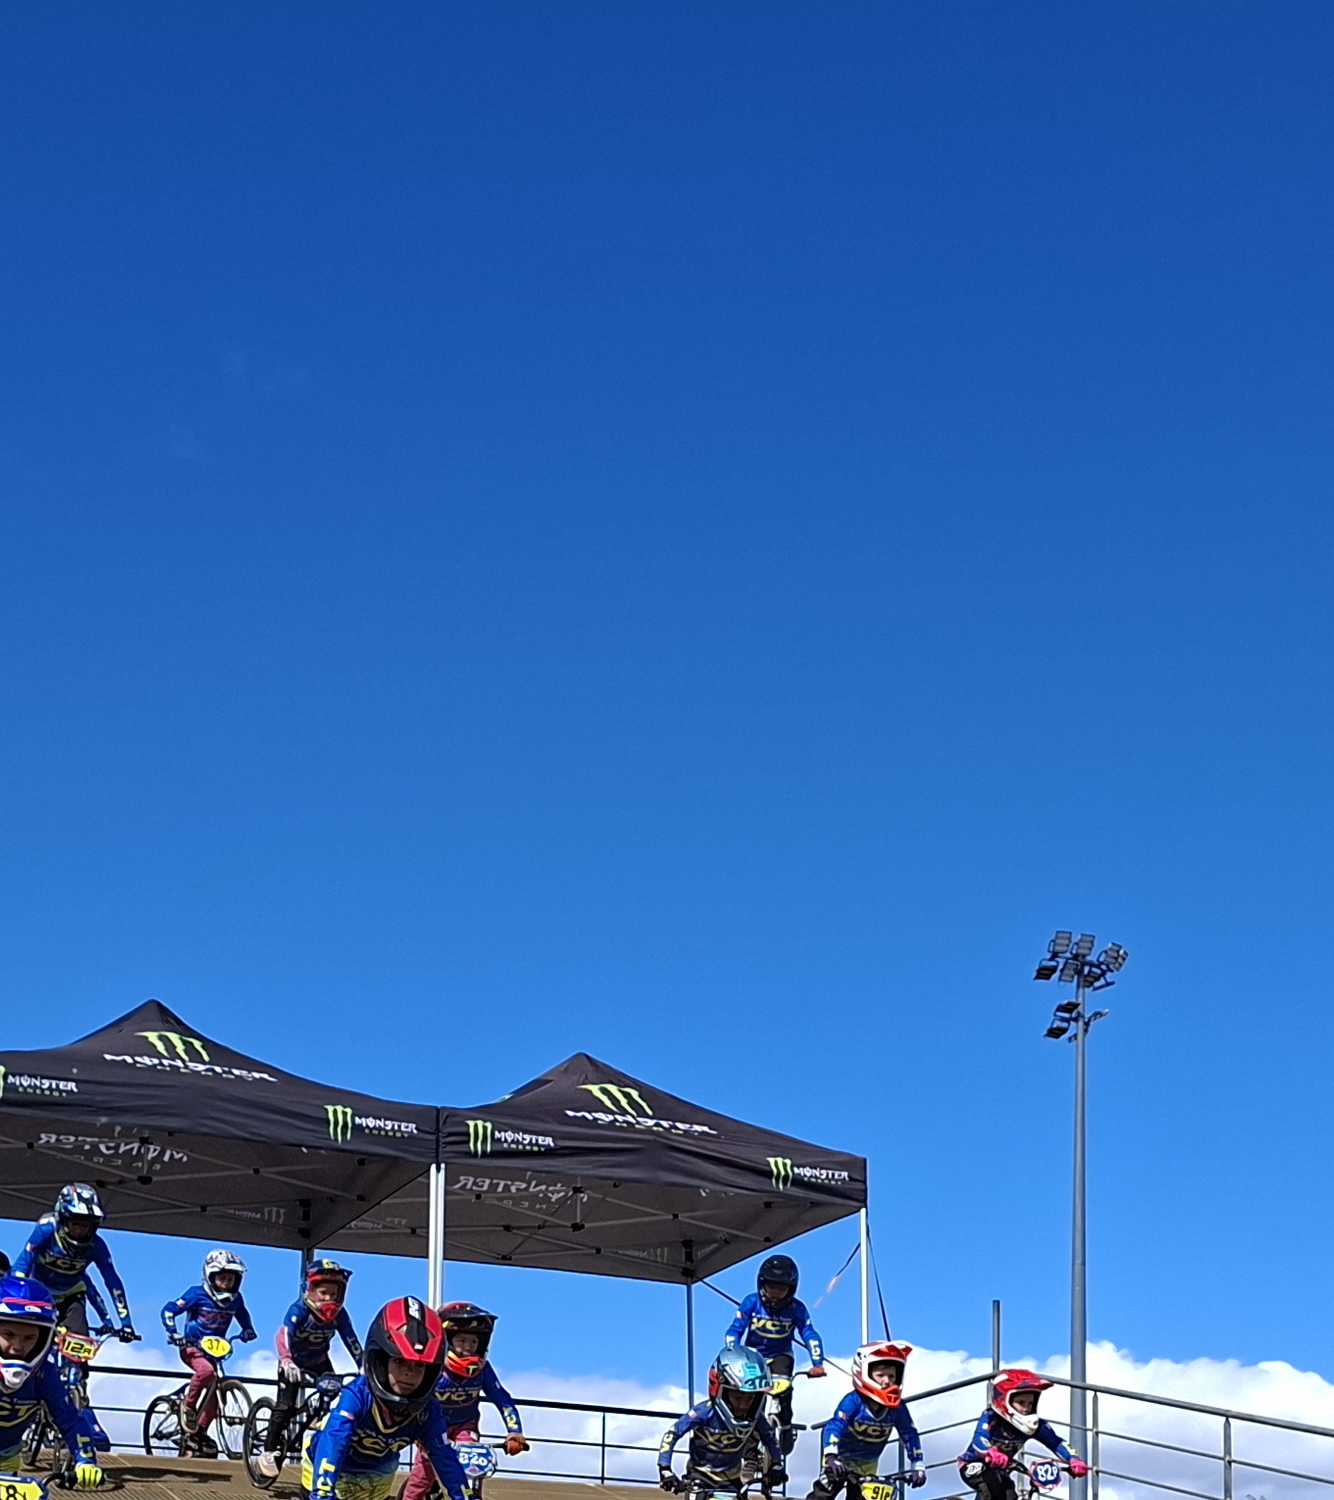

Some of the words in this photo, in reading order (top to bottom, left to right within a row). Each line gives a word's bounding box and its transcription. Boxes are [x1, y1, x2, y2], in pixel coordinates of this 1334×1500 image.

[102, 1053, 279, 1083] MONSTER
[7, 1074, 79, 1093] MONSTER
[354, 1115, 419, 1135] MONSTER
[564, 1109, 719, 1135] MONSTER
[494, 1129, 555, 1147] MONSTER
[793, 1165, 850, 1182] MONSTER
[39, 1254, 87, 1272] VCT
[751, 1317, 793, 1331] VCT
[434, 1389, 480, 1400] VCT
[853, 1421, 892, 1436] VCT
